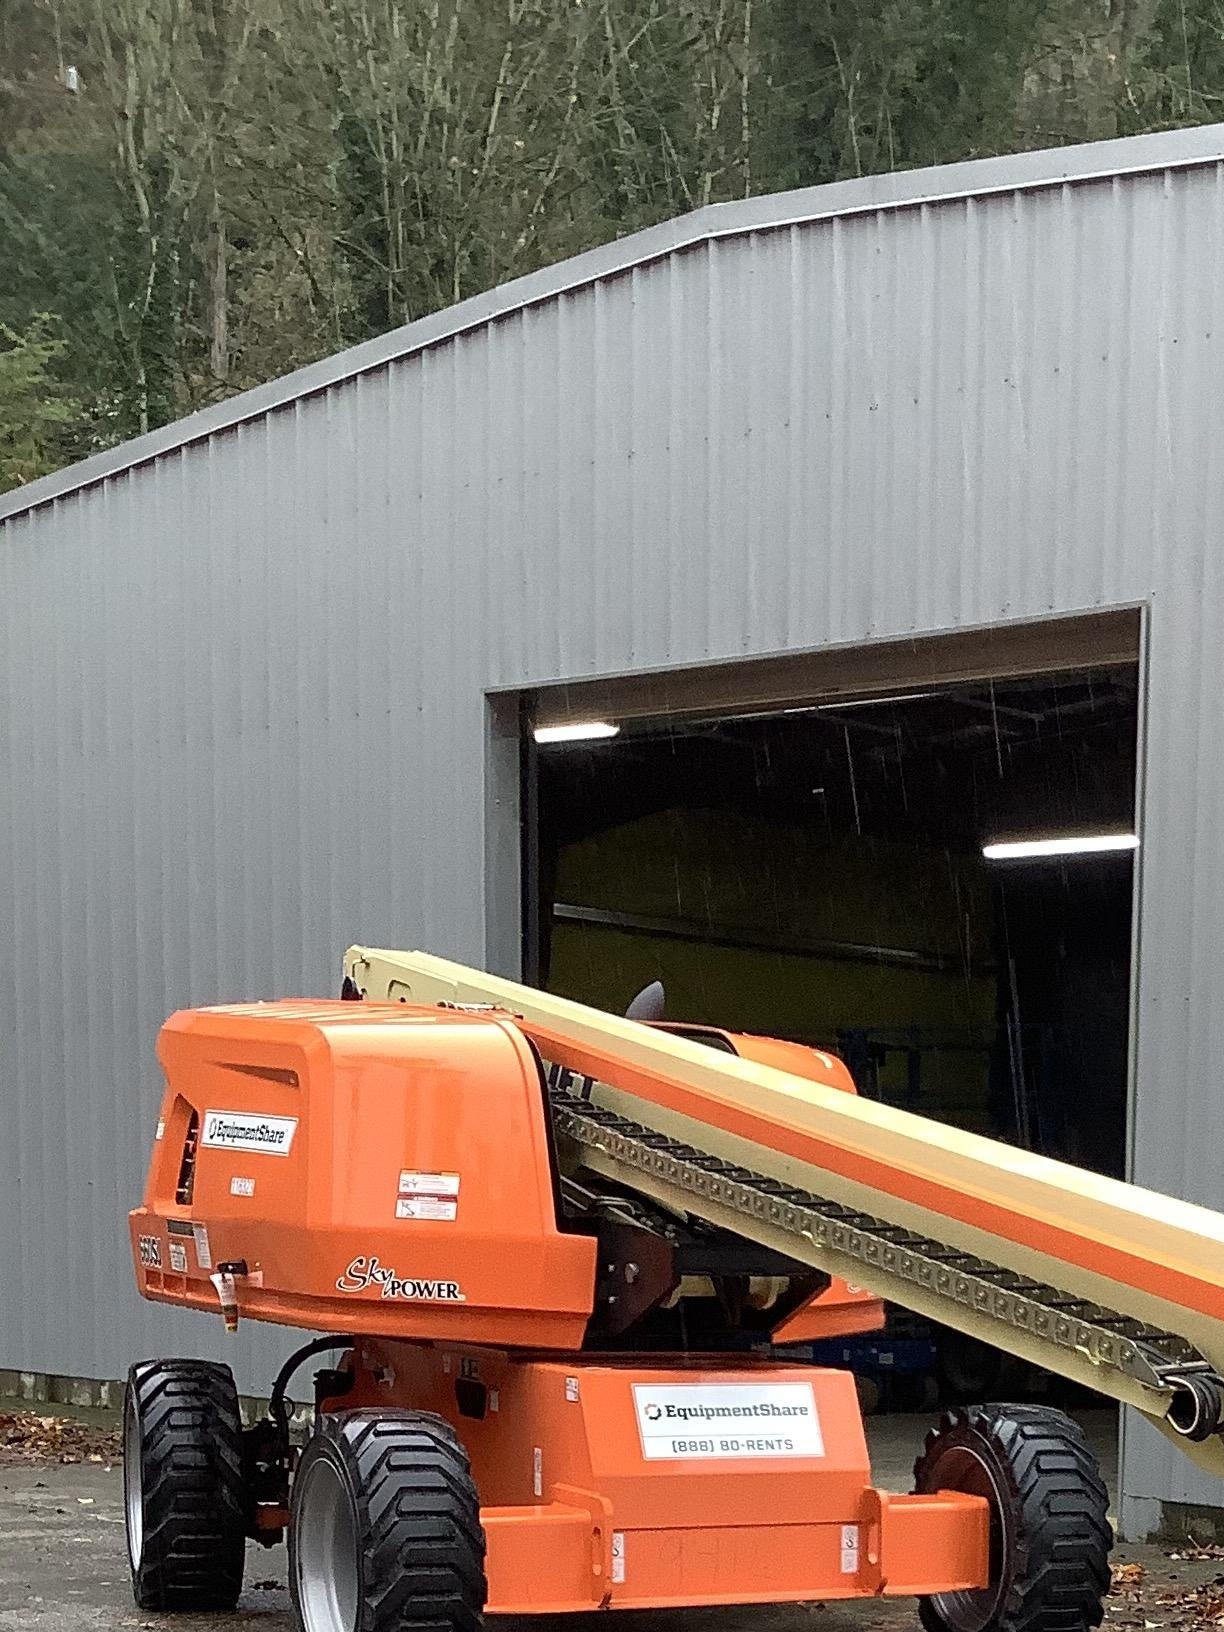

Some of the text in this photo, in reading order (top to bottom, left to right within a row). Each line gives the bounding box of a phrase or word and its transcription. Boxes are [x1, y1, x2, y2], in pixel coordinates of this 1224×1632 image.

[216, 1121, 285, 1144] EquipmentShare
[664, 1404, 809, 1420] EquipmentShare
[672, 1438, 793, 1453] (888) 80-RENTS
